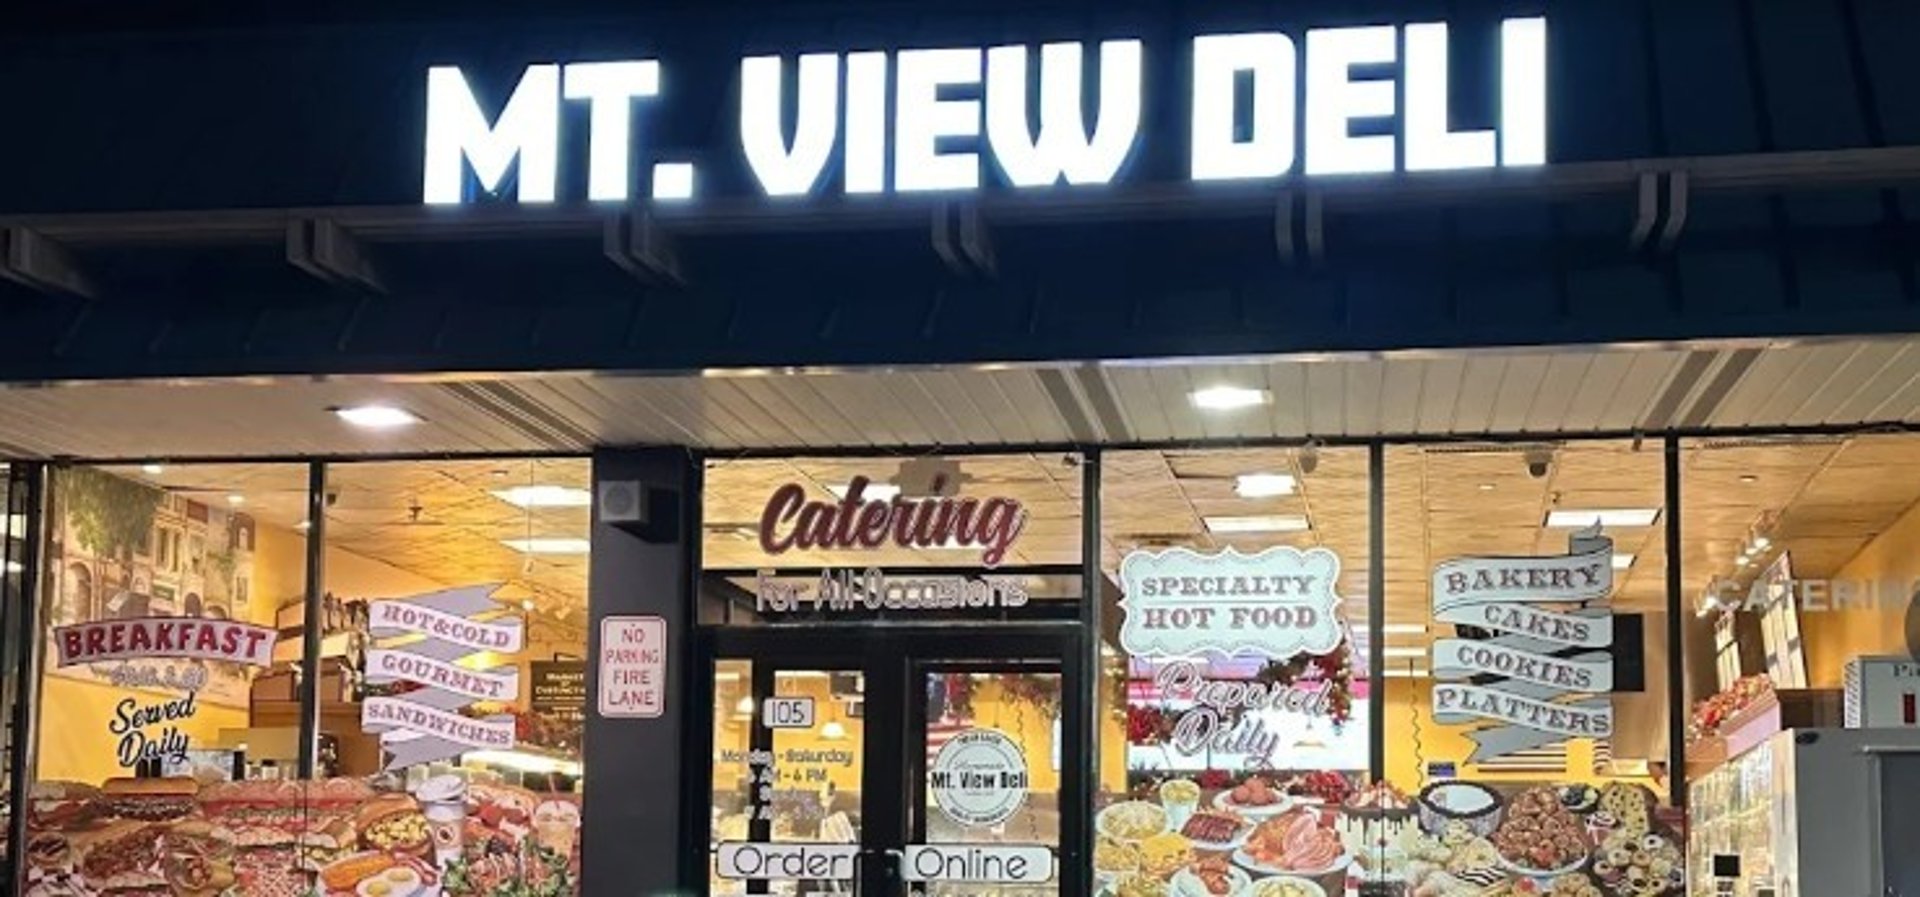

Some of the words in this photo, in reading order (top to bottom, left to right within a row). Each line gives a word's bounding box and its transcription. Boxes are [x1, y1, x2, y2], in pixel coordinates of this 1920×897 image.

[424, 60, 693, 203] MT.
[741, 39, 1141, 195] VIEW
[1192, 17, 1546, 180] DELI
[759, 475, 1027, 569] Catering
[756, 568, 810, 612] For
[814, 567, 856, 610] All
[862, 567, 1029, 610] Occasions
[1142, 576, 1316, 597] SPECIALTY
[1446, 563, 1603, 594] BAKERY
[383, 604, 510, 647] HOT&COLD
[622, 628, 646, 643] NO
[1142, 607, 1215, 628] HOT
[1229, 607, 1317, 628] FOOD
[1485, 605, 1590, 642] CAKES
[64, 623, 266, 659] BREAKFAST
[605, 649, 660, 664] PARKING
[381, 655, 503, 697] GOURMET
[613, 669, 651, 685] FIRE
[1457, 646, 1593, 688] COOKIES
[608, 690, 655, 706] LANE
[1157, 660, 1333, 718] Prepared
[109, 690, 196, 735] Served
[368, 704, 511, 745] SANDWICHES
[772, 701, 805, 724] 105
[1436, 688, 1610, 733] PLATTERS
[117, 726, 190, 769] Daily
[1173, 704, 1280, 771] Daily
[786, 748, 853, 767] Saturday
[806, 768, 828, 783] PM
[931, 771, 956, 789] Mt.
[959, 770, 996, 789] View
[1000, 771, 1029, 789] Deli
[733, 846, 849, 877] Order
[914, 847, 1028, 879] Online
